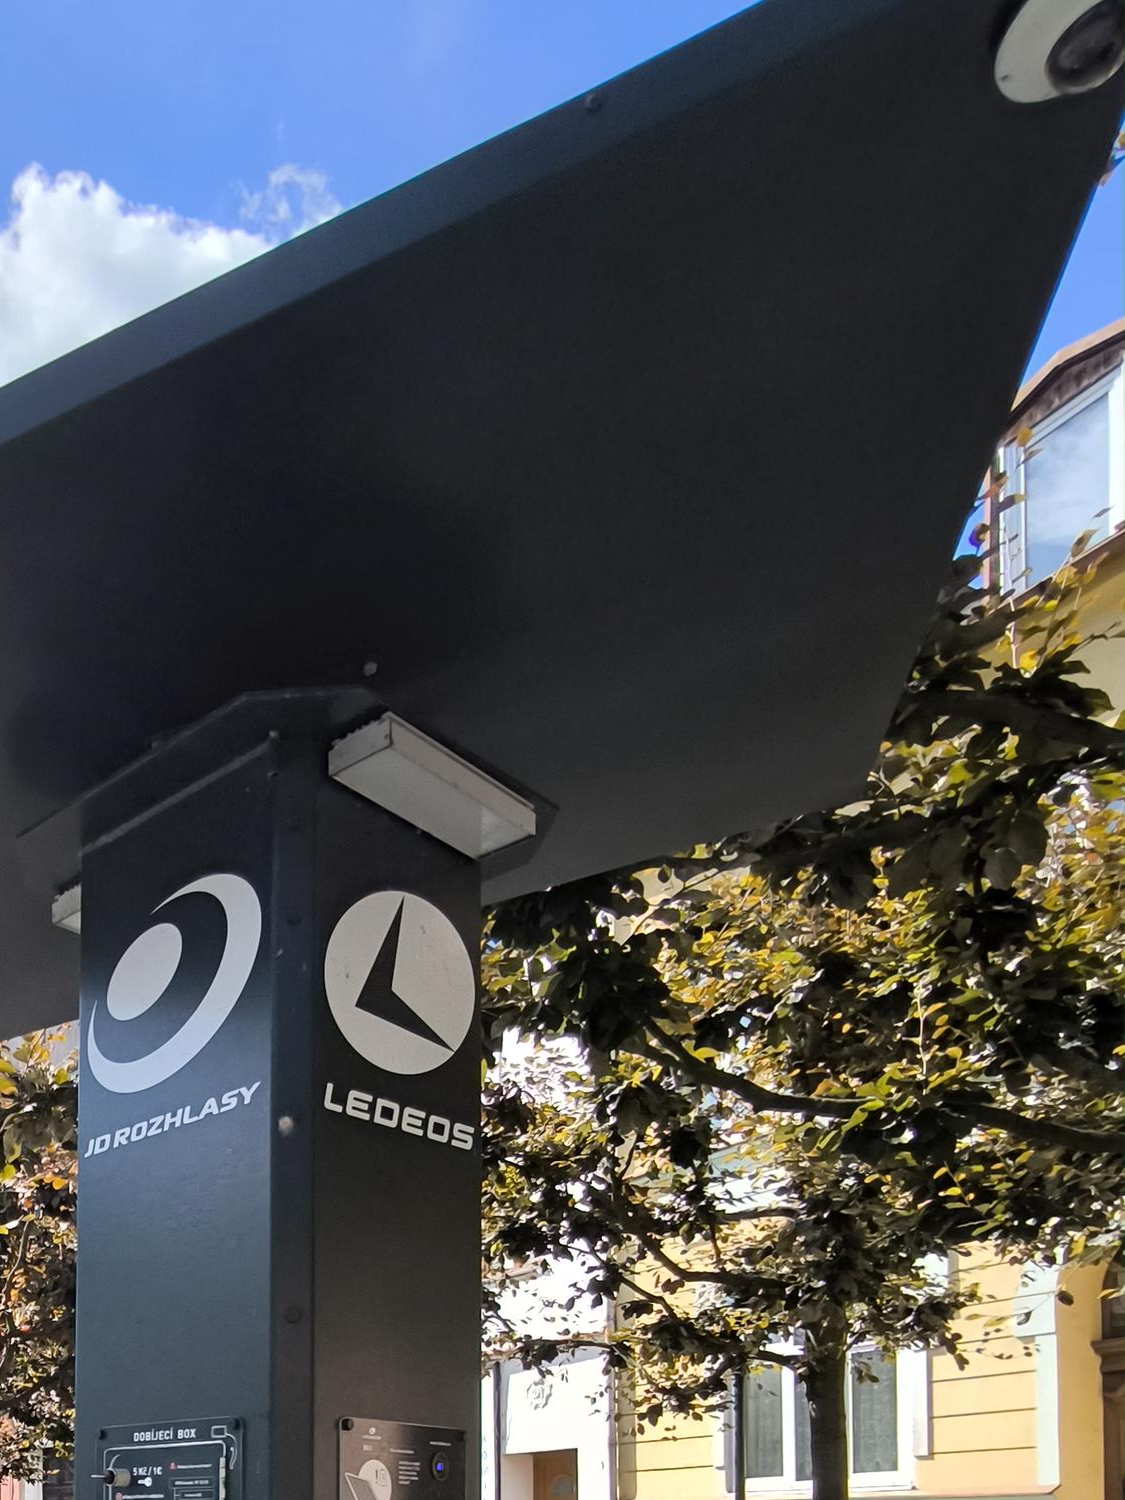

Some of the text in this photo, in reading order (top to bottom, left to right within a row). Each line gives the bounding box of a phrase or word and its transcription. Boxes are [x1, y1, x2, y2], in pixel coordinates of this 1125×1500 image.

[83, 1080, 262, 1159] JD ROZHLASY
[324, 1082, 475, 1151] LEDEOS
[177, 1428, 196, 1440] BOX
